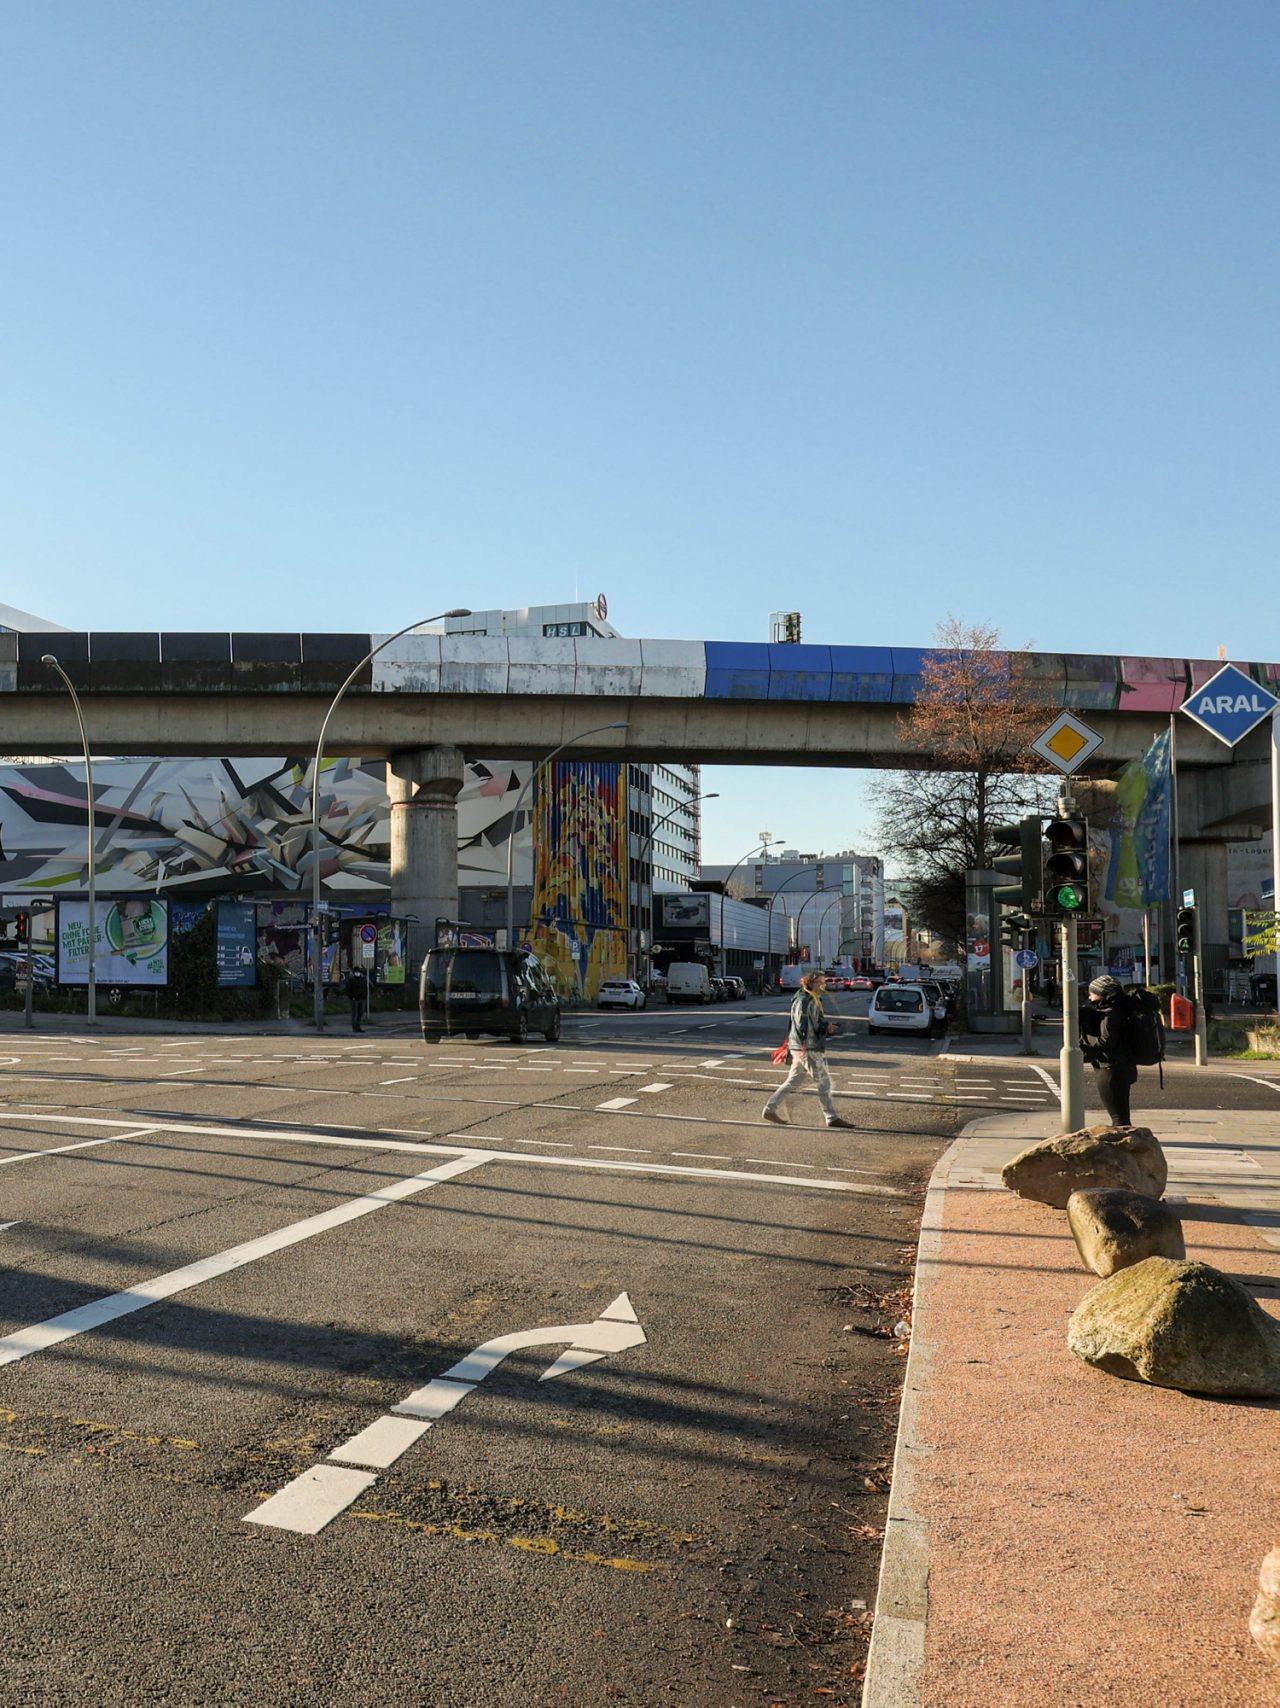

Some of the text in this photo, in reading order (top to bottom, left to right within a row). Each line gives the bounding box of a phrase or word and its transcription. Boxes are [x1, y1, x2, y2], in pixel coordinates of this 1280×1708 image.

[546, 625, 579, 637] HSL
[1198, 694, 1266, 715] ARAL
[62, 929, 81, 940] OHNE
